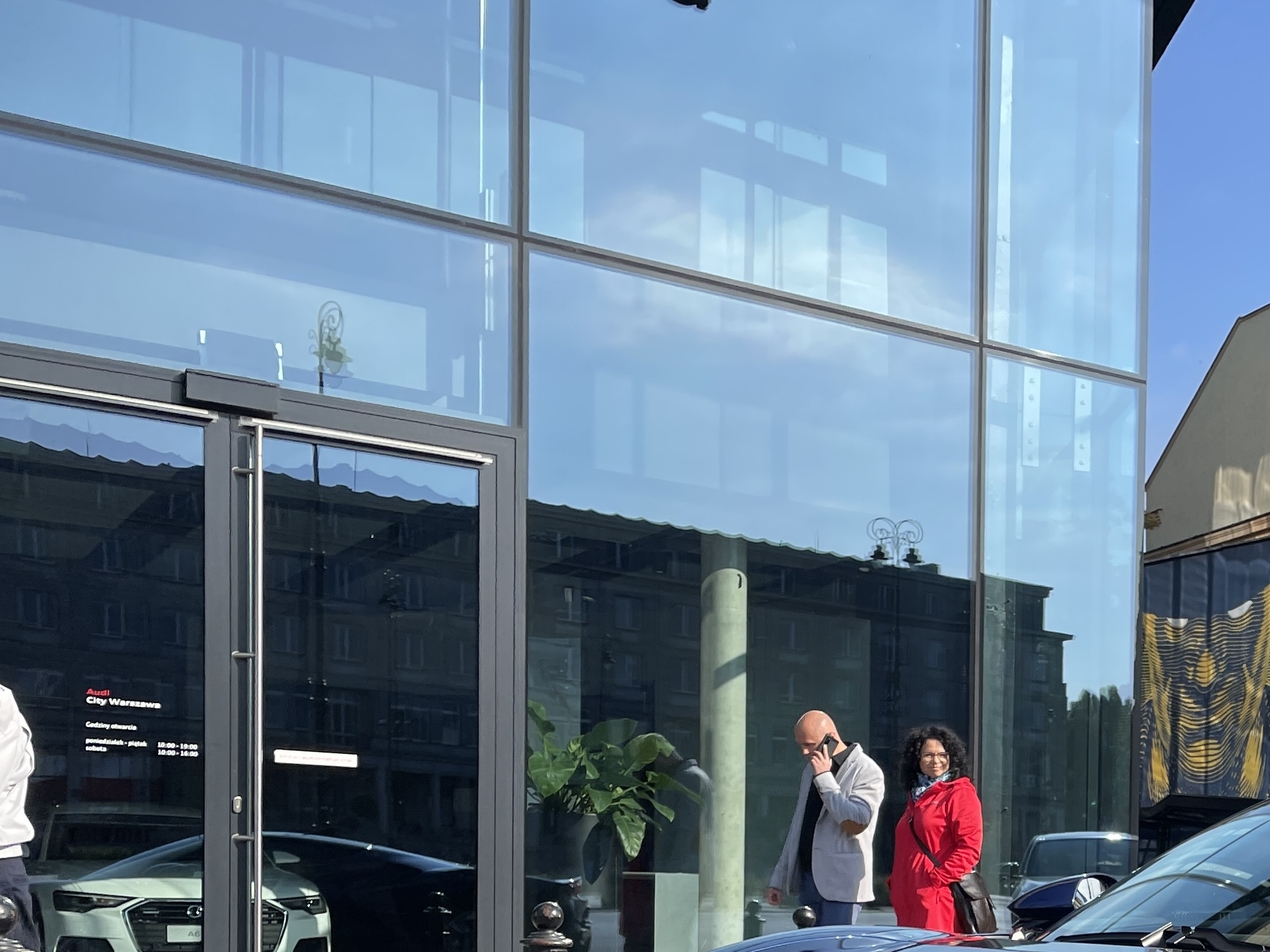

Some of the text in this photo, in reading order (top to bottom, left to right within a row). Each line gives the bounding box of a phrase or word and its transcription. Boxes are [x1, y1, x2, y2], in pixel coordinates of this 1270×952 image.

[86, 688, 110, 696] Audi
[86, 696, 161, 709] City Warszawa
[85, 721, 110, 730] Godziny
